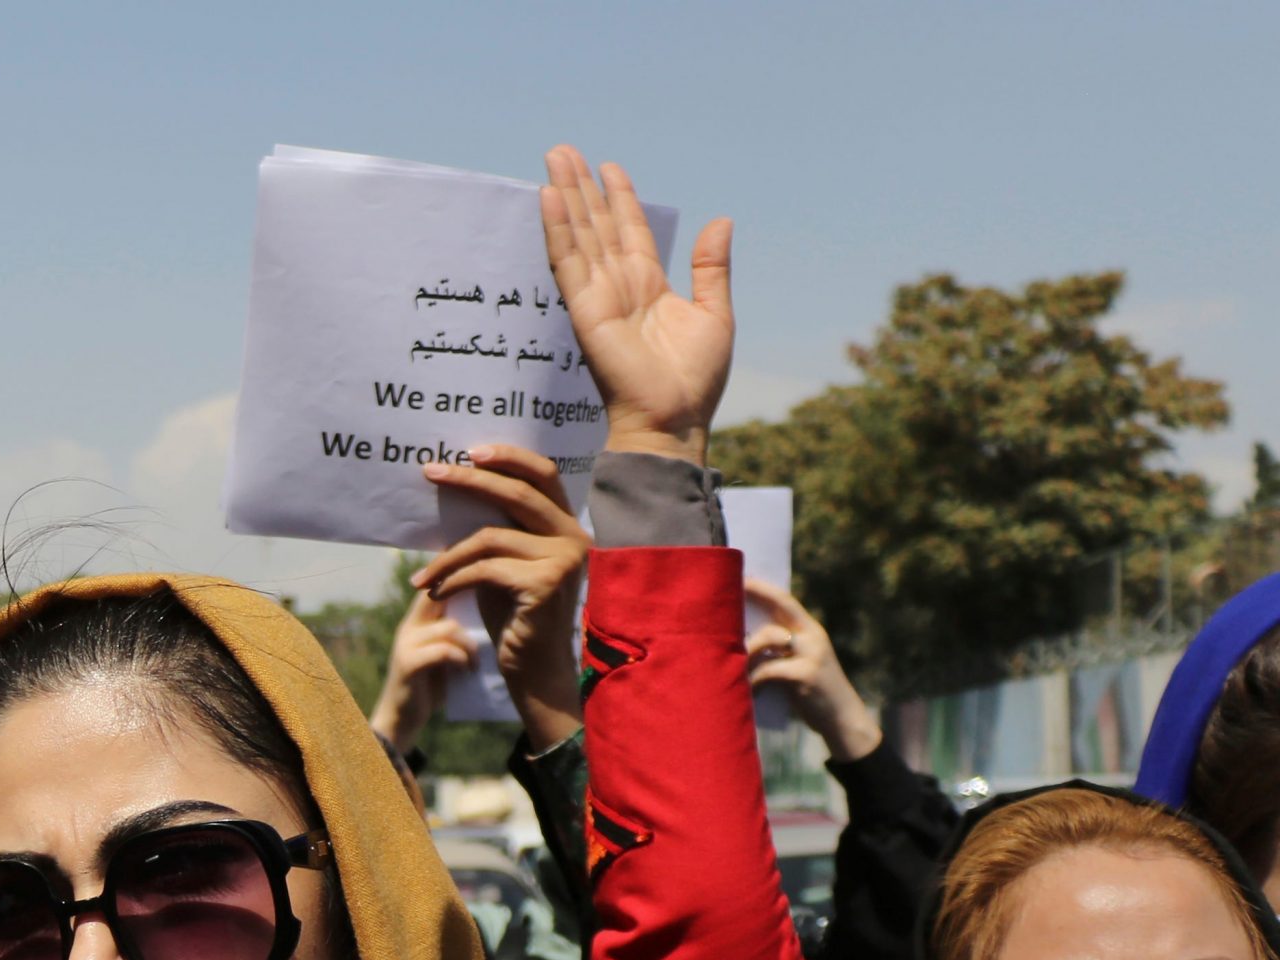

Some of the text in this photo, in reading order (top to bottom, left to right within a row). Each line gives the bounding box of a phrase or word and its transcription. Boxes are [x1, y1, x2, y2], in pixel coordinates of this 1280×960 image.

[414, 279, 485, 309] هستیم
[496, 286, 522, 315] هم
[535, 287, 549, 316] با
[410, 331, 508, 362] شکستیم
[516, 339, 555, 370] ستم
[560, 351, 572, 372] و
[374, 382, 606, 428] We are all together
[321, 432, 372, 460] We
[383, 435, 471, 467] broke
